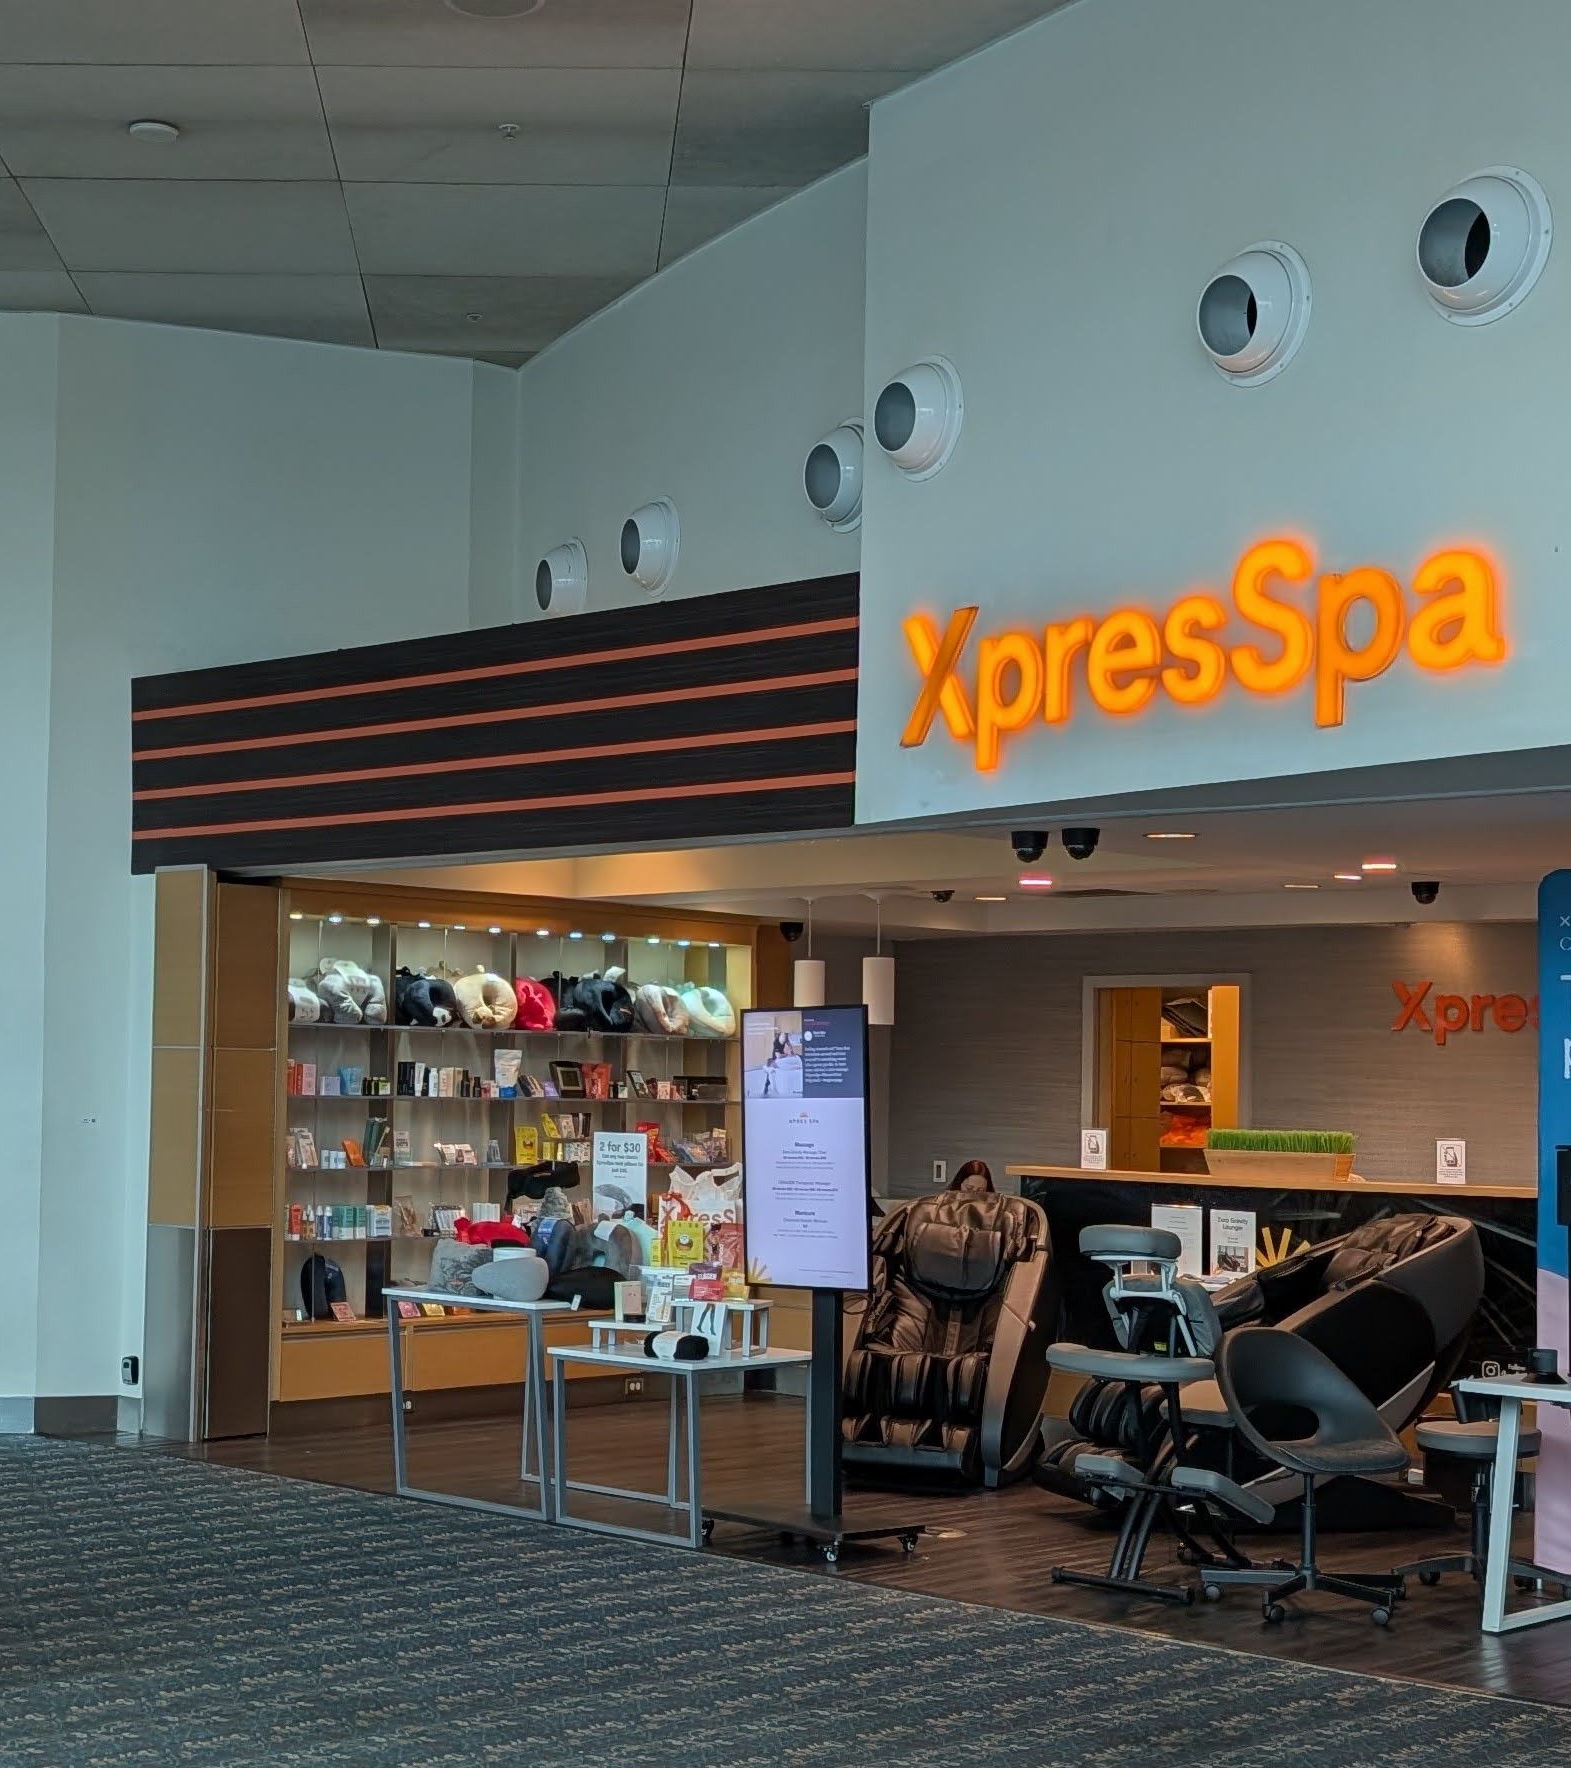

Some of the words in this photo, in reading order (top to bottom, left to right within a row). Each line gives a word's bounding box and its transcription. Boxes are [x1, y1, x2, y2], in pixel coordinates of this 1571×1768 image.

[900, 538, 1506, 772] XpresSpa
[599, 1141, 605, 1151] 2
[607, 1140, 621, 1152] for
[623, 1142, 641, 1153] $30
